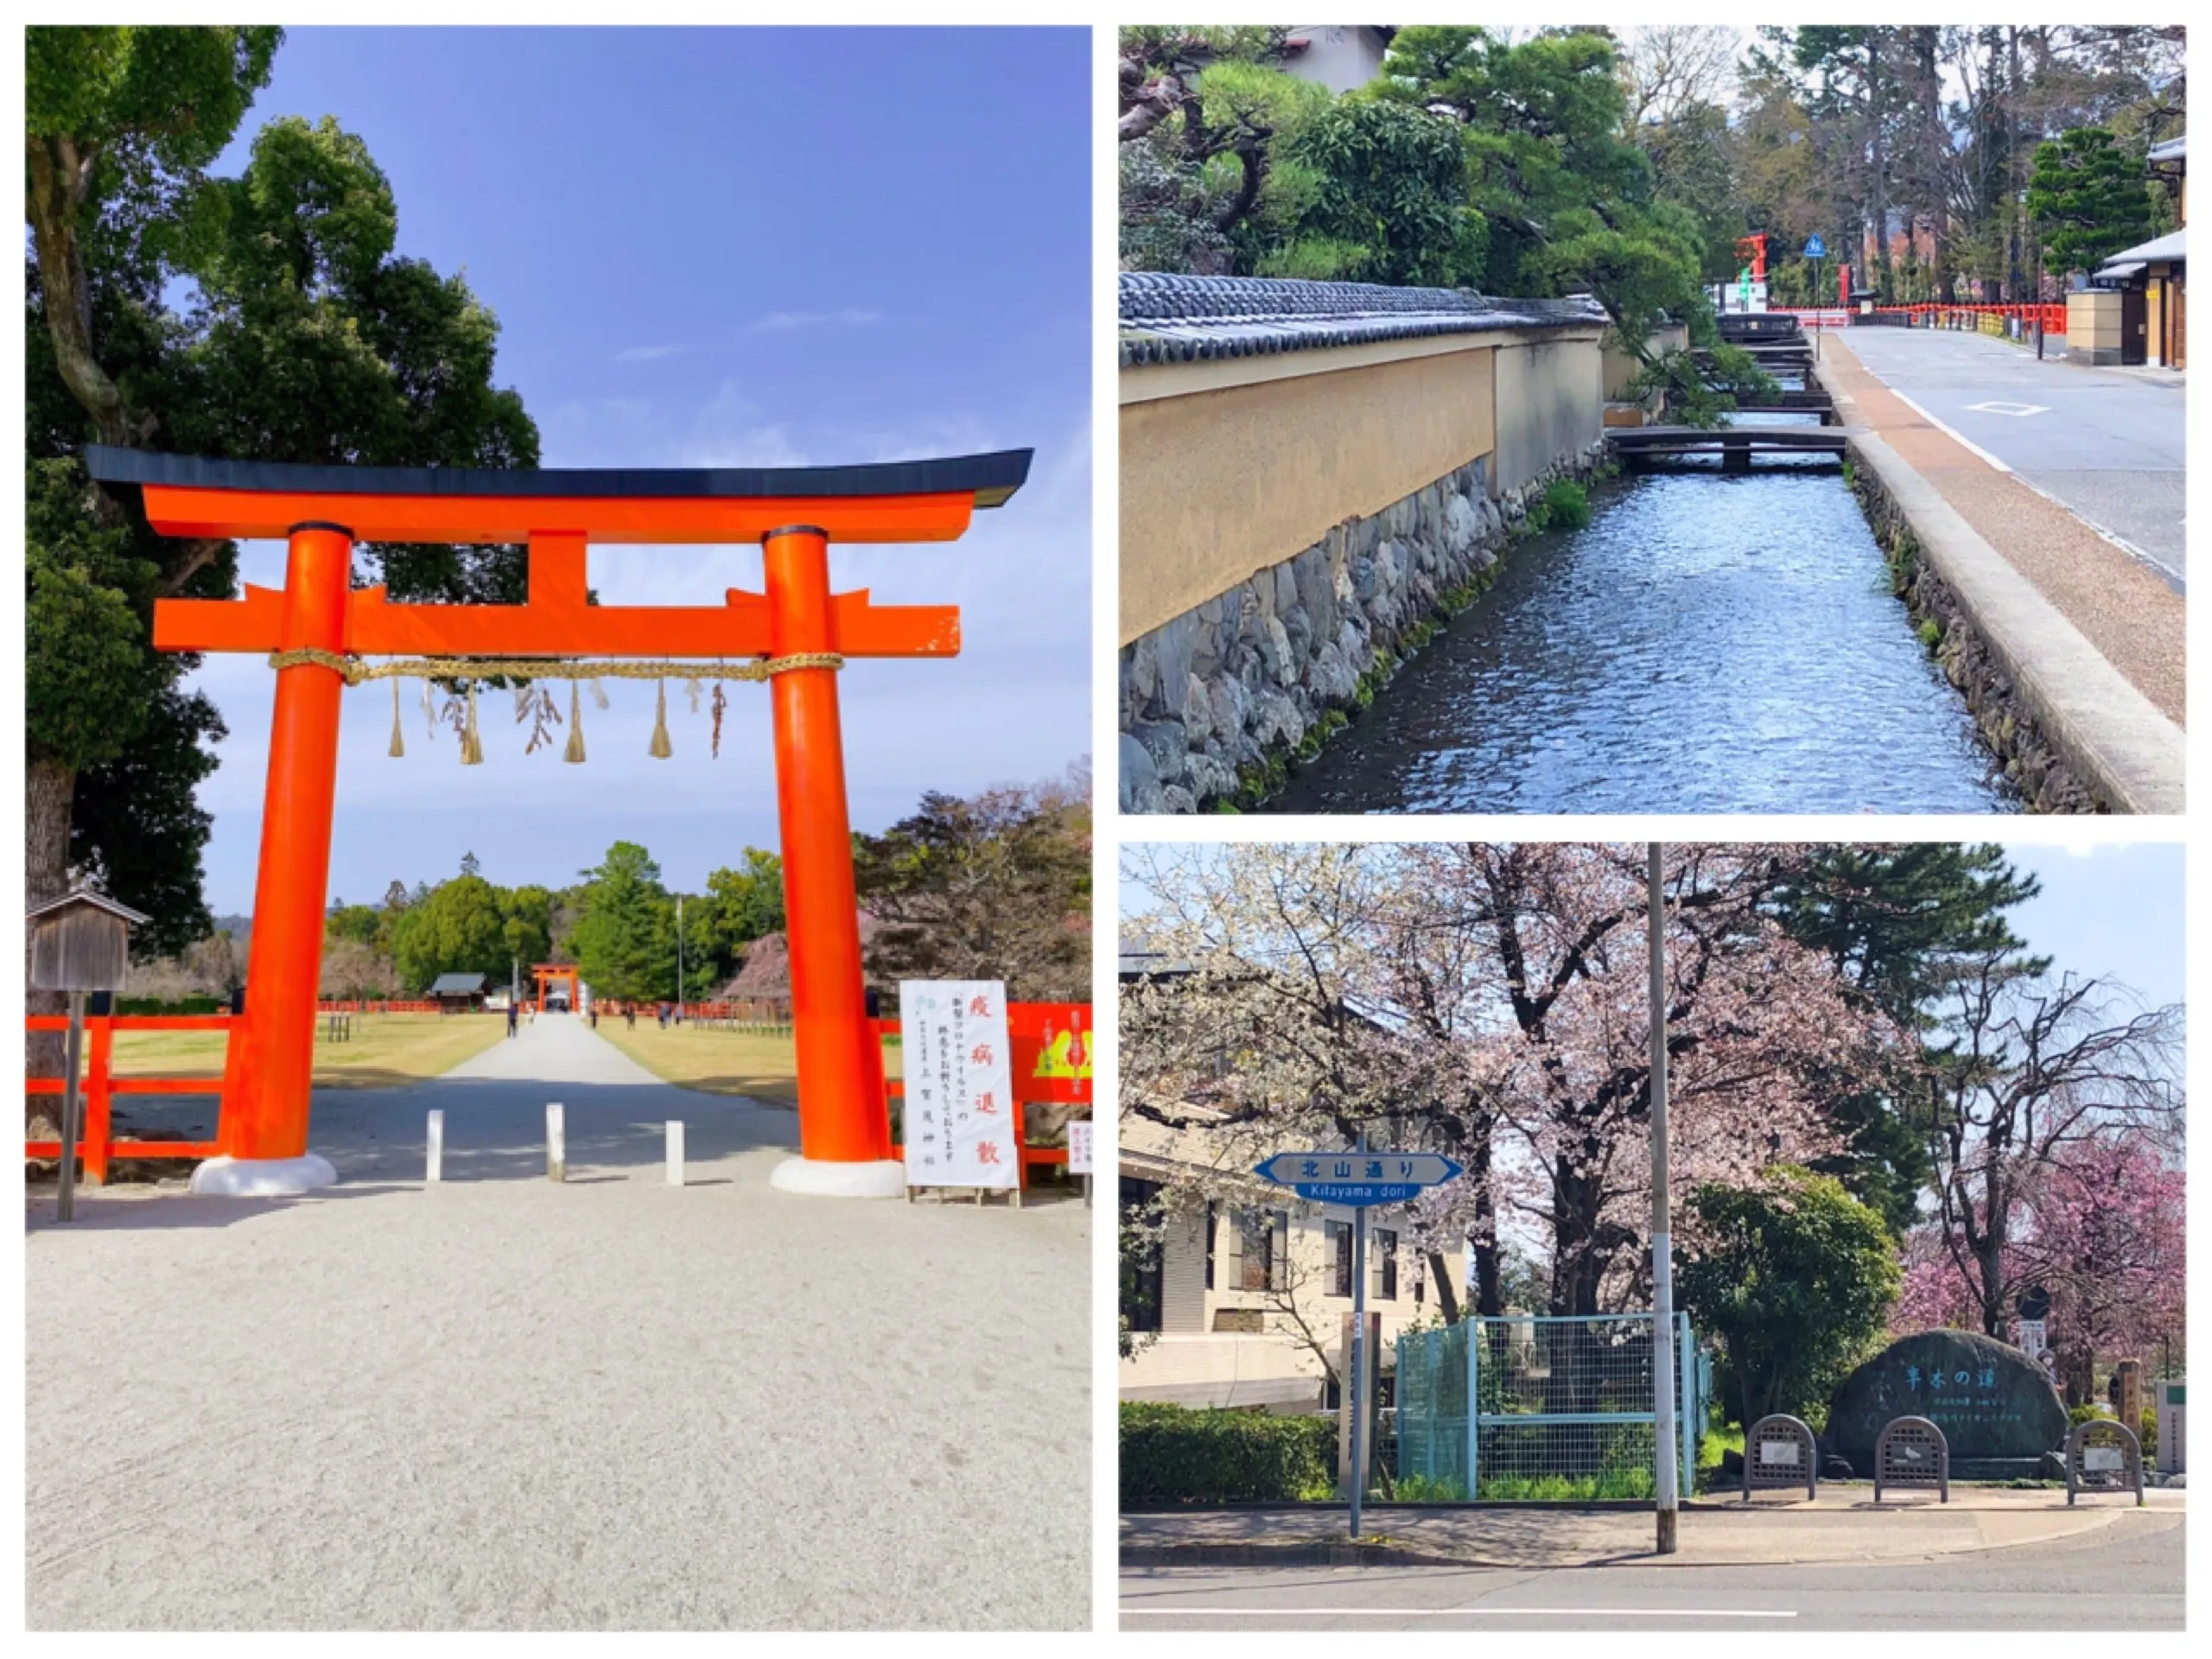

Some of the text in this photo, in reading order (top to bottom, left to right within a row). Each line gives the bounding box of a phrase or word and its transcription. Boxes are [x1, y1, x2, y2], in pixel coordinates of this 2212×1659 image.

[969, 995, 1001, 1166] 疫病退散
[1302, 1160, 1413, 1179] 北山通り
[1310, 1184, 1406, 1199] Kitayama dori
